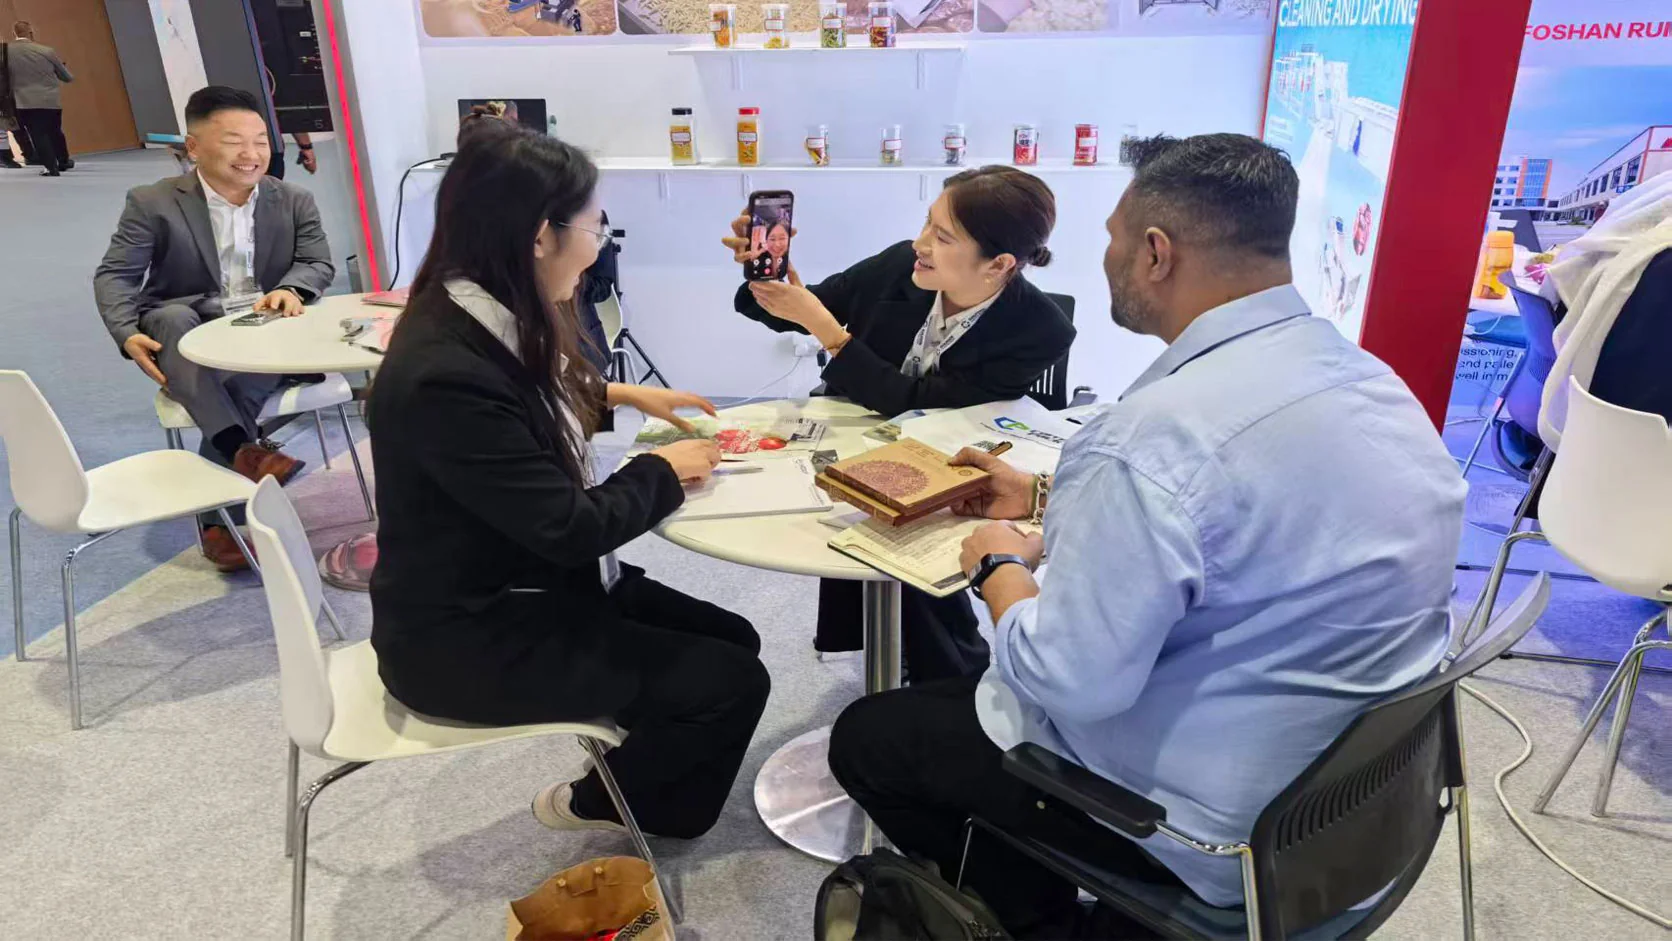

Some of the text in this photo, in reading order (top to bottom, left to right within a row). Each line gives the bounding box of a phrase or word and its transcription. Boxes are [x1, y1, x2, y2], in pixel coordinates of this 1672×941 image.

[1279, 0, 1418, 27] CLEANING AND DRYING
